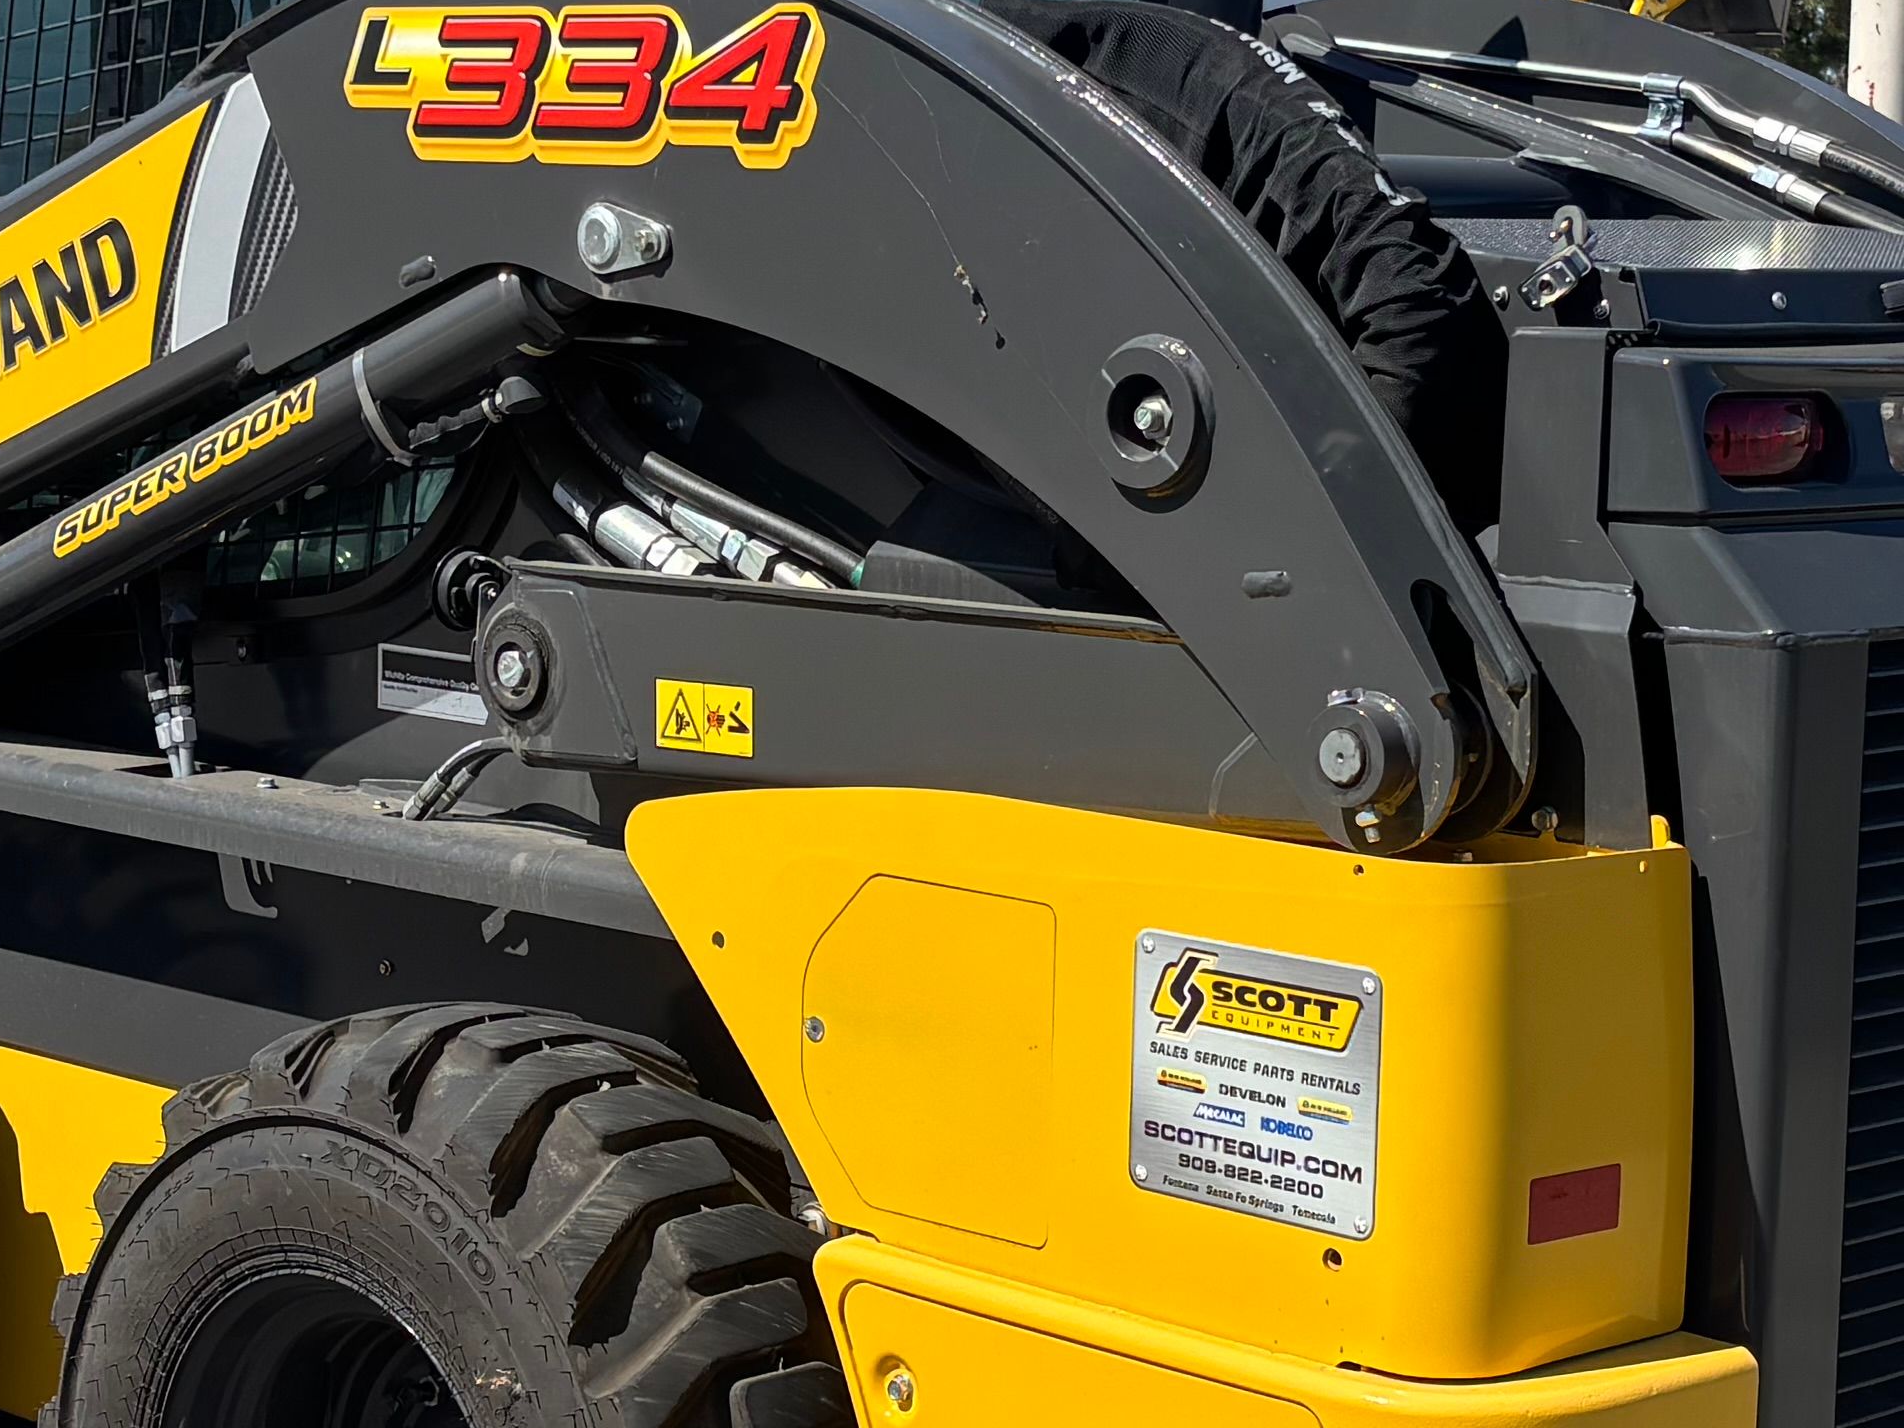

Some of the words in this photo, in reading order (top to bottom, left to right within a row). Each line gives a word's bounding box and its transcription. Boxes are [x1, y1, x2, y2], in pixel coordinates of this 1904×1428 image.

[346, 9, 814, 148] L334
[55, 456, 186, 553] SUPER
[192, 379, 316, 479] BOOM
[1212, 980, 1338, 1022] SCOTT
[1211, 1010, 1336, 1042] EQUIPMENT
[1149, 1041, 1188, 1060] SALES
[1194, 1050, 1247, 1072] SERVICE
[1253, 1063, 1294, 1081] PARTS
[1301, 1072, 1361, 1095] RENTALS
[1219, 1084, 1287, 1108] DEVELON
[1144, 1120, 1362, 1184] SCOTTEQUIP.COM
[1260, 1116, 1313, 1141] KOBELCO
